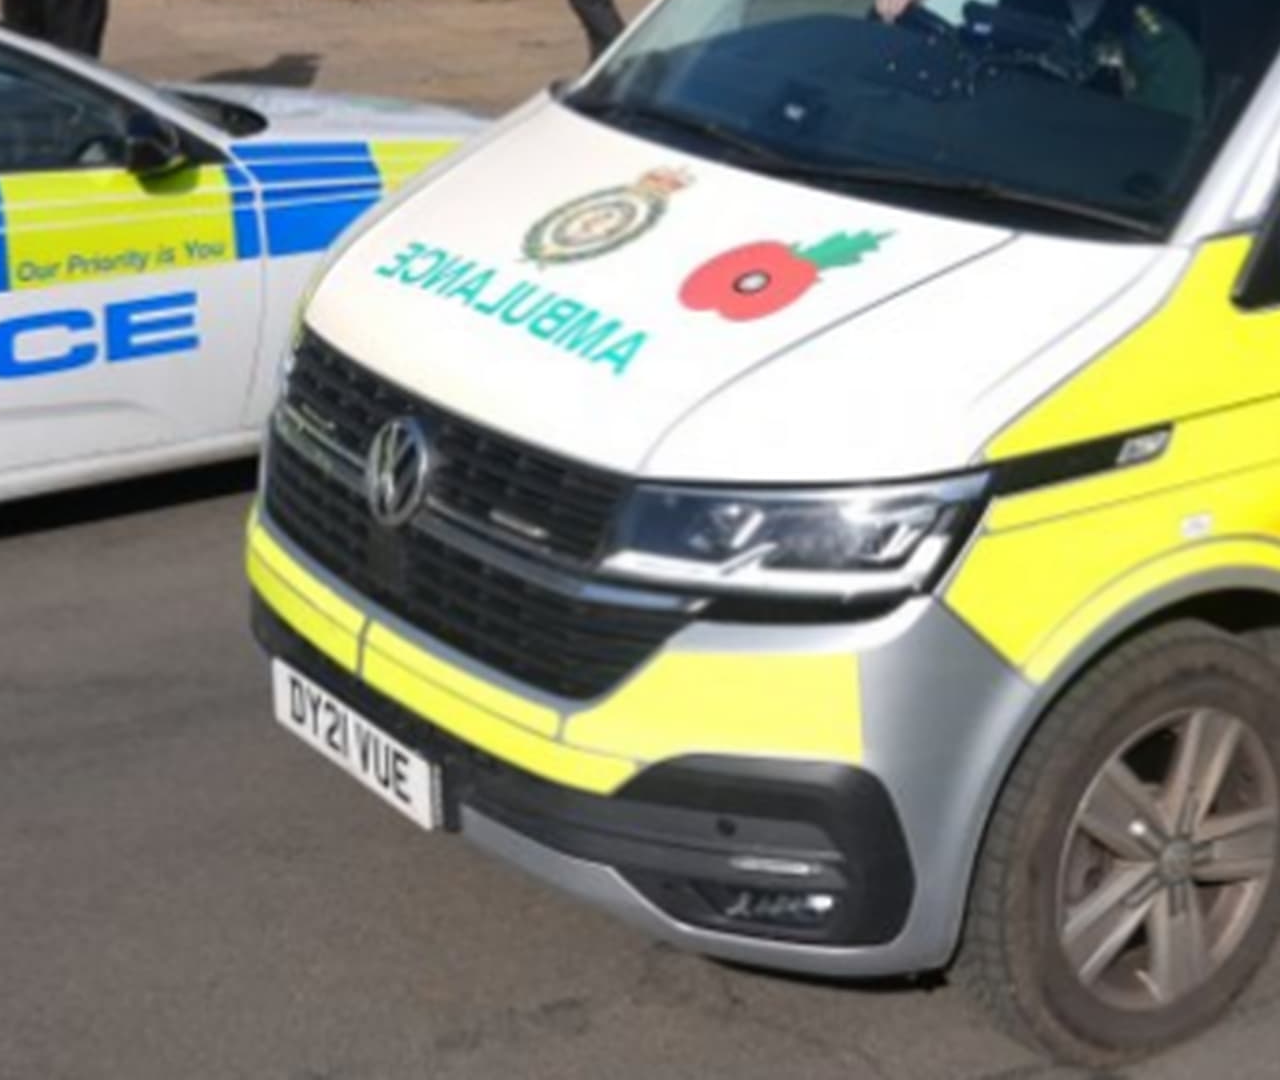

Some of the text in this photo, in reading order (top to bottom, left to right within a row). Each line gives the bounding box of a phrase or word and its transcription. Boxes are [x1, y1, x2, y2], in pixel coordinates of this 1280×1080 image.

[17, 240, 226, 282] Our Priority is You
[288, 673, 413, 806] DY21 VUE
